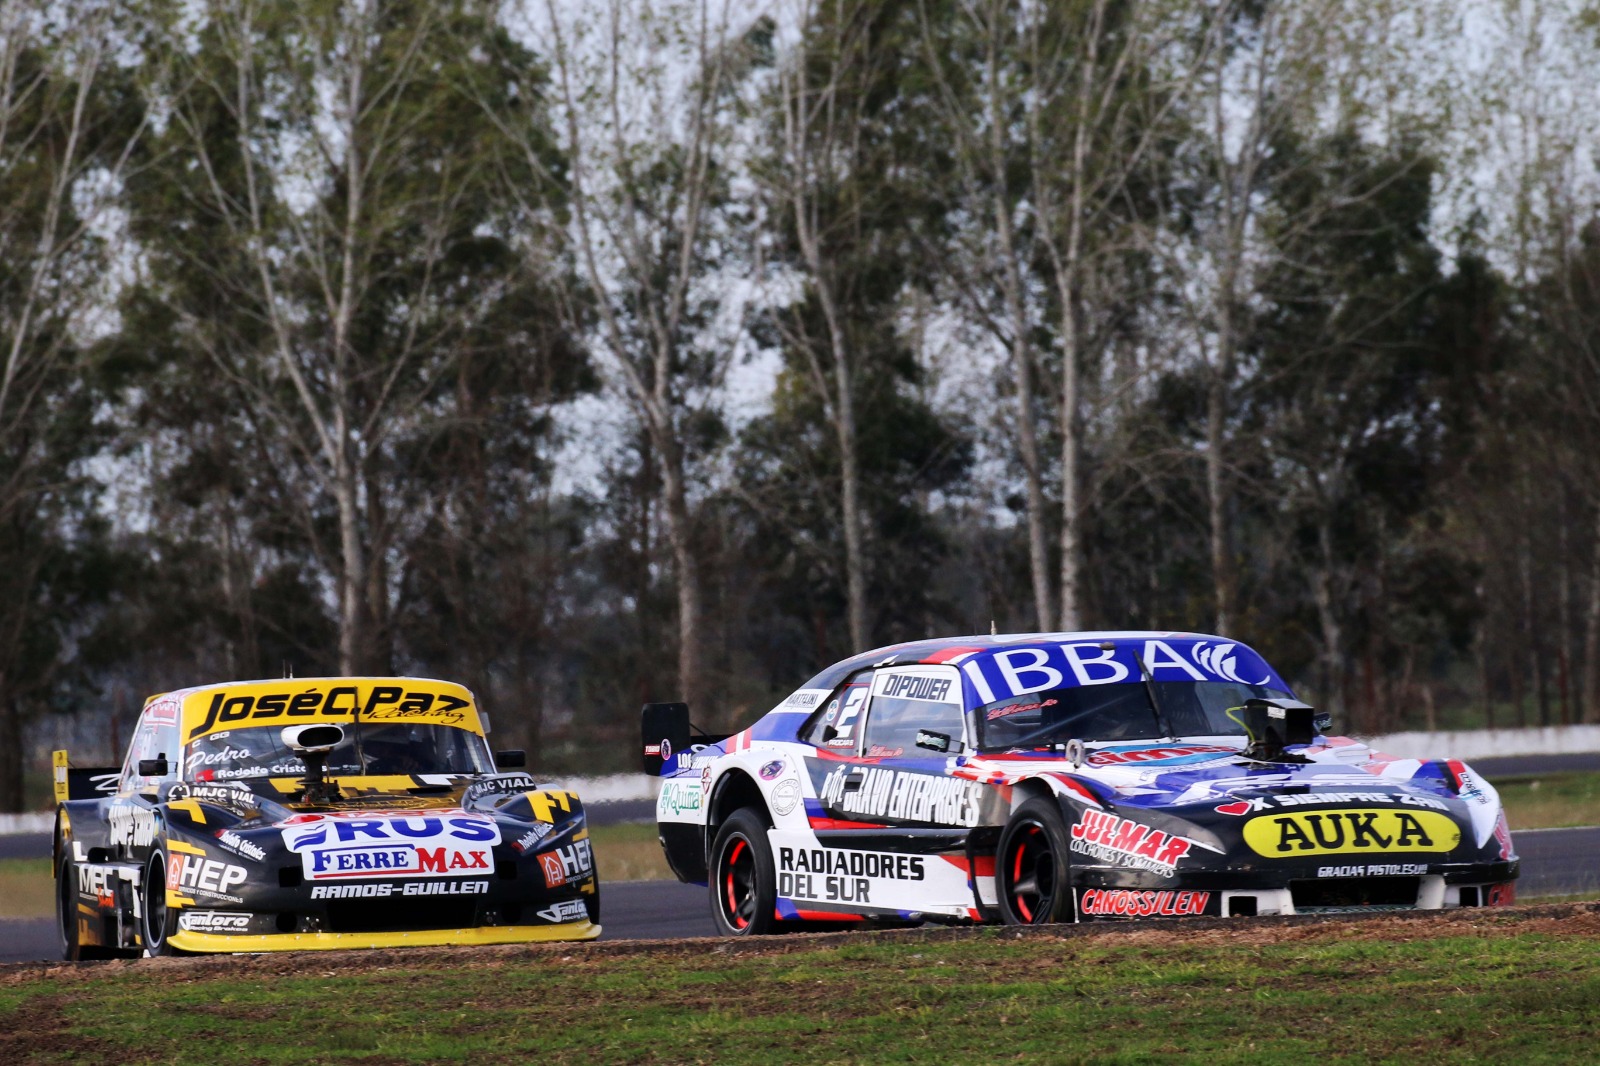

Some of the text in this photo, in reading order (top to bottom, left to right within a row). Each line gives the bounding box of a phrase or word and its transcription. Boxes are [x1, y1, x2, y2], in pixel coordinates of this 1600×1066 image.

[883, 674, 952, 701] DIPOWER
[834, 687, 869, 738] 2
[185, 745, 251, 775] Pedro
[217, 766, 268, 779] Rodolfo
[271, 764, 328, 774] Cristas
[192, 787, 255, 804] MJC VIAL
[475, 777, 535, 794] MJC VIAL
[888, 771, 984, 828] ENTERPRISES
[1273, 792, 1395, 807] SIEMPRE
[1071, 808, 1191, 868] JULMAR
[1273, 812, 1434, 852] AUKA
[180, 855, 248, 894] HEP
[779, 846, 925, 881] RADIADORES
[1317, 865, 1366, 877] GRACIAS
[310, 881, 490, 900] RAMOS-GUILLEN
[778, 872, 871, 903] DEL SUR
[1080, 888, 1211, 917] CANOSSILEN
[179, 910, 254, 931] Santoro
